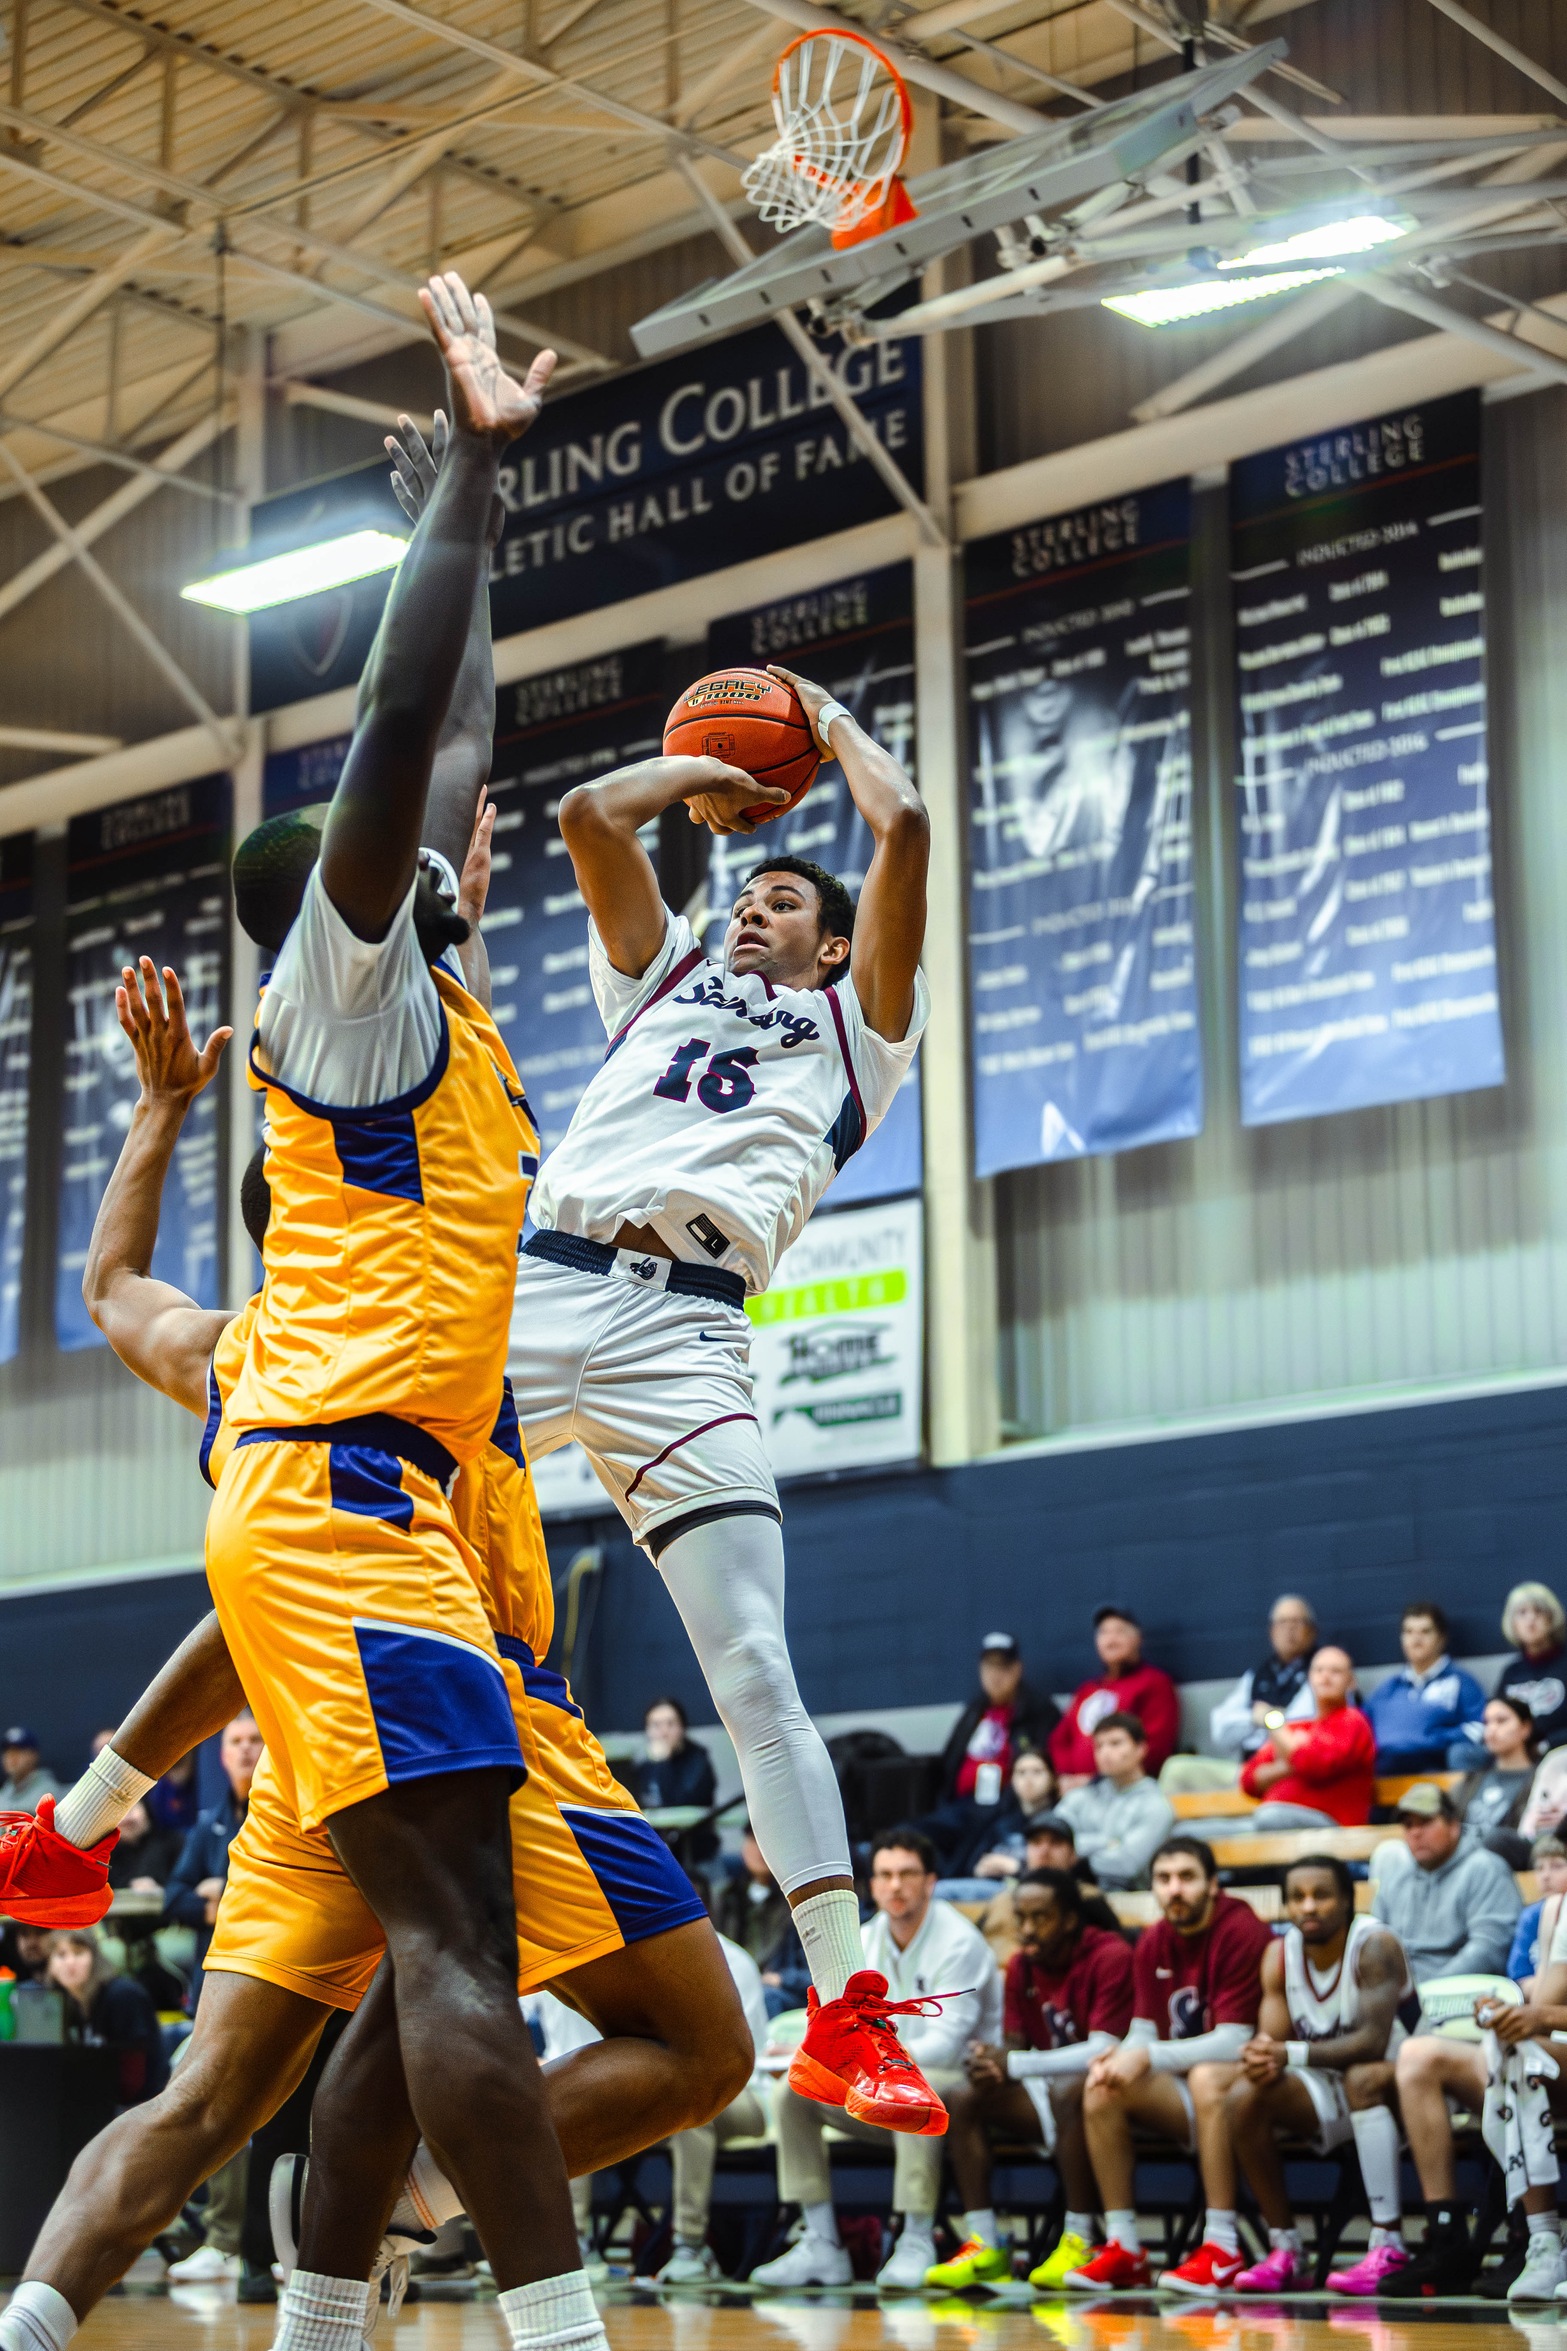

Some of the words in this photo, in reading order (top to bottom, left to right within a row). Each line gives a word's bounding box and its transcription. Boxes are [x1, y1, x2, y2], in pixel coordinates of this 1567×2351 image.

[499, 421, 642, 513] RLING
[659, 338, 905, 455] COLLEGE
[1285, 413, 1424, 473] STERLING
[1284, 439, 1423, 497] COLLEGE
[489, 514, 595, 583] LETIC
[608, 478, 713, 543] HALL
[725, 452, 780, 500] OF
[684, 679, 773, 703] LEGACY
[705, 691, 762, 702] 1000
[653, 1037, 761, 1114] 15
